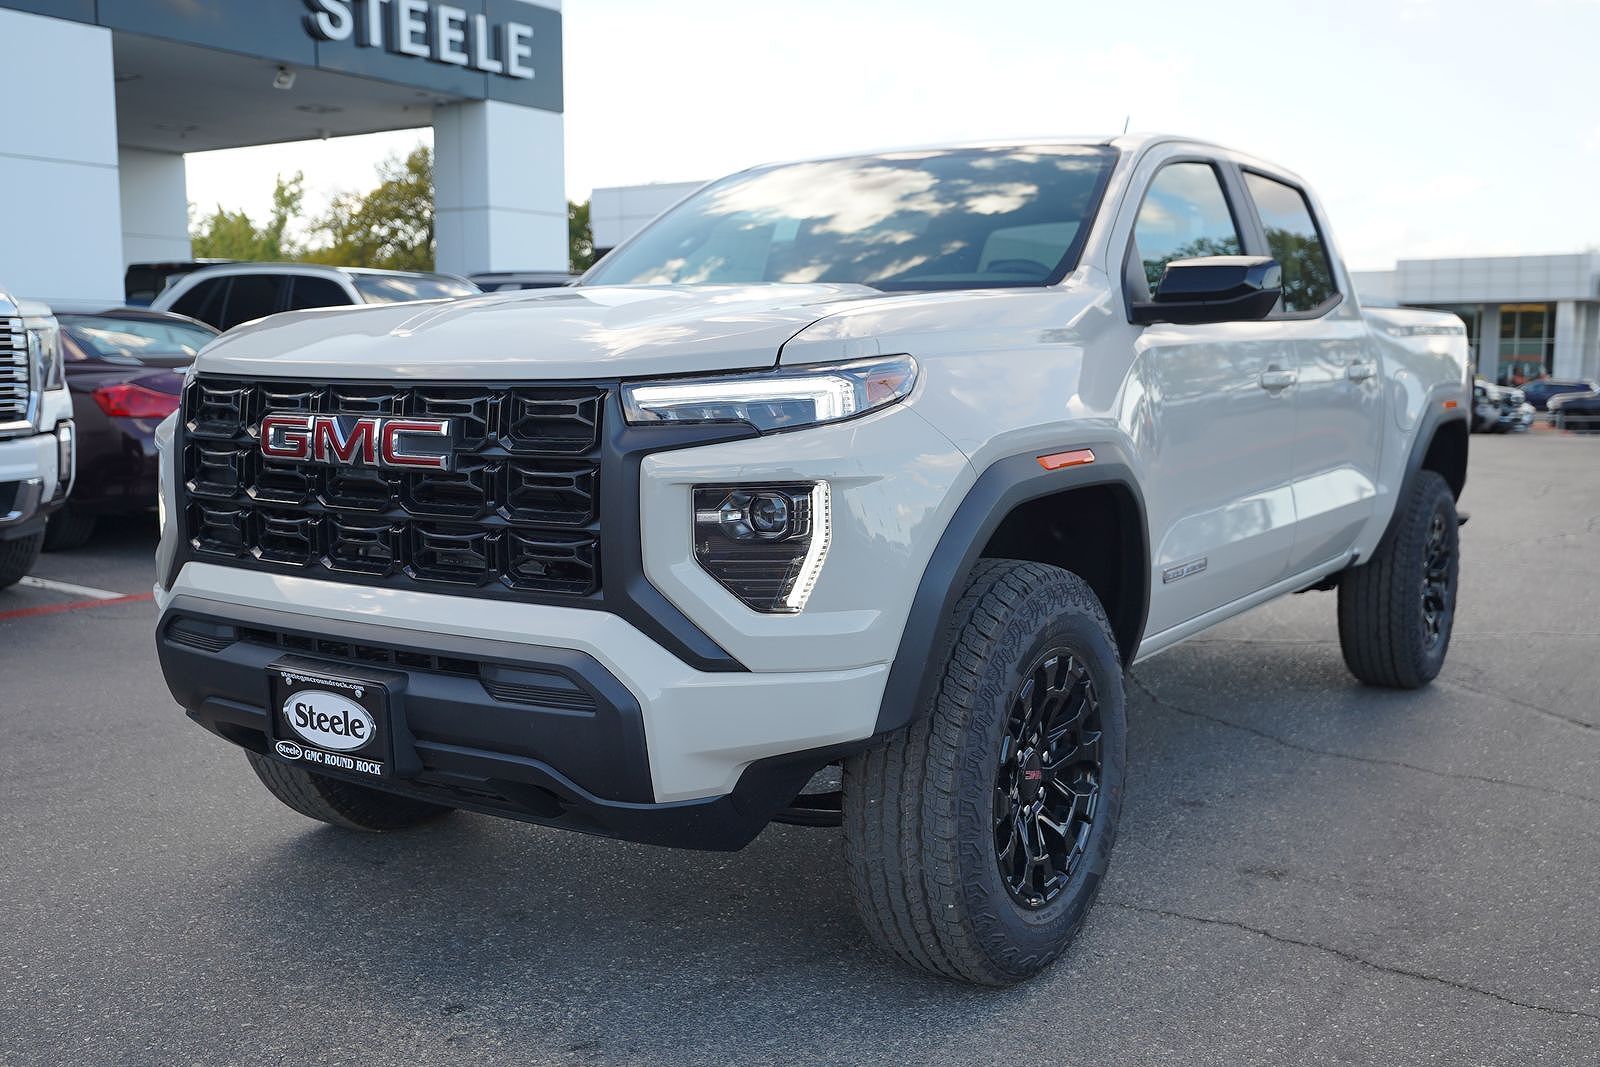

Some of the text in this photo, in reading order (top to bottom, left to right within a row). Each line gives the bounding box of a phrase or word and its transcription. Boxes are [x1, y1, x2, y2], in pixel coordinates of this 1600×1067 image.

[314, 0, 535, 79] STEELE
[260, 415, 449, 471] GMC
[295, 702, 365, 739] Steele
[279, 744, 381, 775] Steele GMC ROUND ROCK
